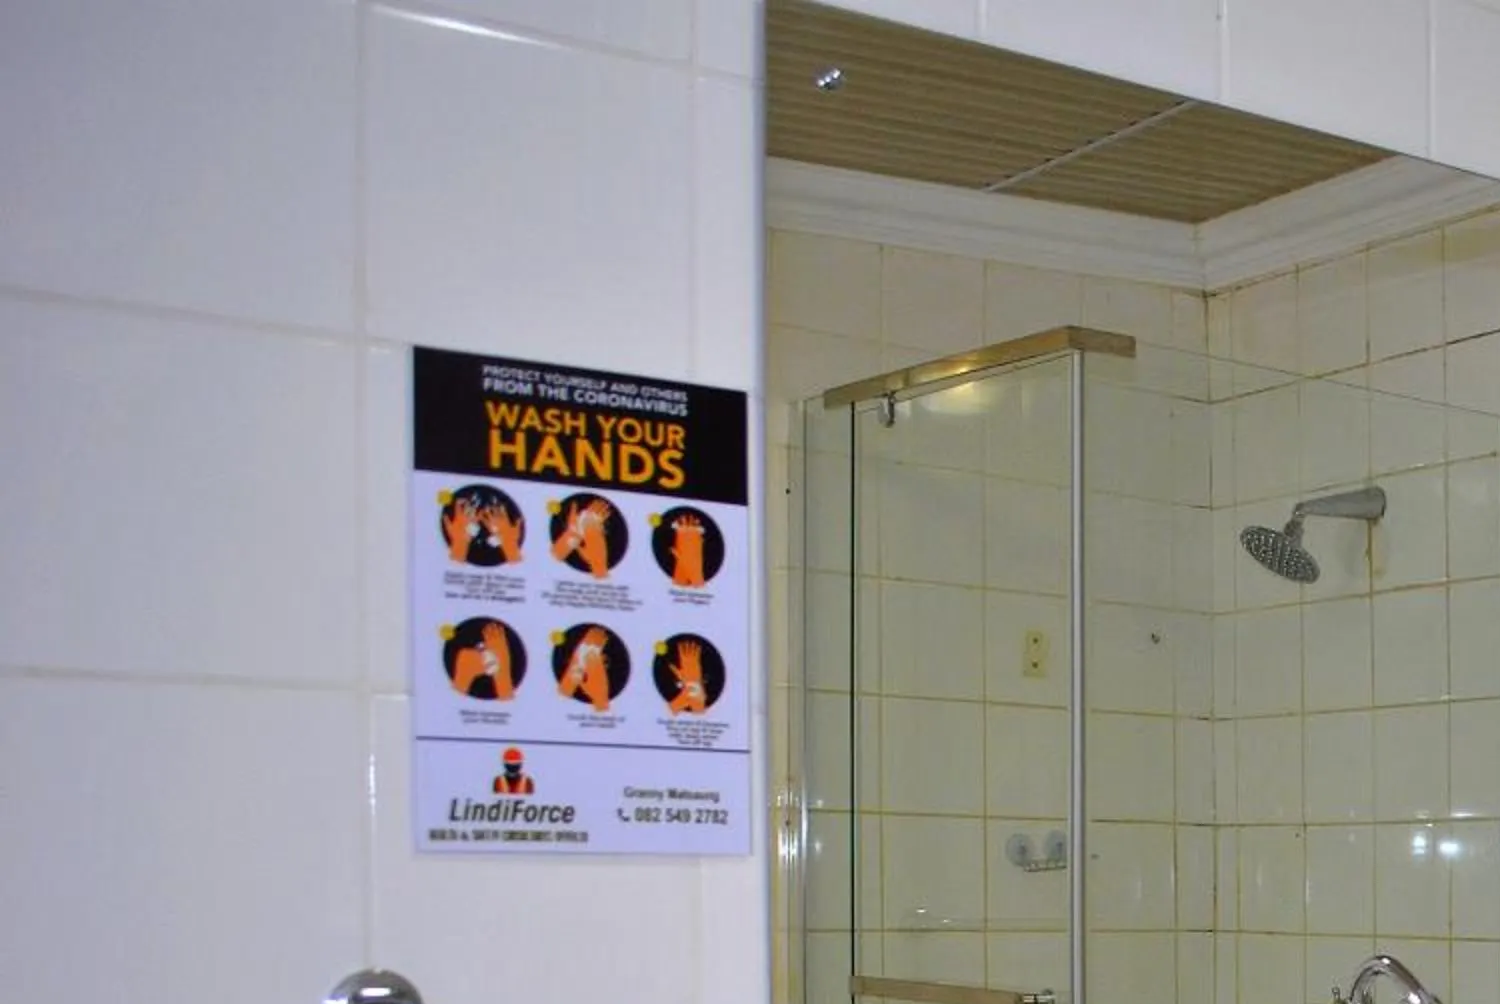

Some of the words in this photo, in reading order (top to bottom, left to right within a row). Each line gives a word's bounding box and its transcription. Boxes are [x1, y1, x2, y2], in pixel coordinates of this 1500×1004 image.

[482, 364, 540, 382] PROTECT
[610, 381, 638, 396] AND
[640, 385, 688, 402] OTHERS
[483, 378, 533, 396] FROM
[538, 384, 569, 401] THE
[573, 388, 689, 417] CORONAVIRUS
[486, 401, 587, 437] WASH
[596, 414, 687, 450] YOUR
[489, 429, 686, 489] HANDS
[449, 799, 576, 823] LindiForce
